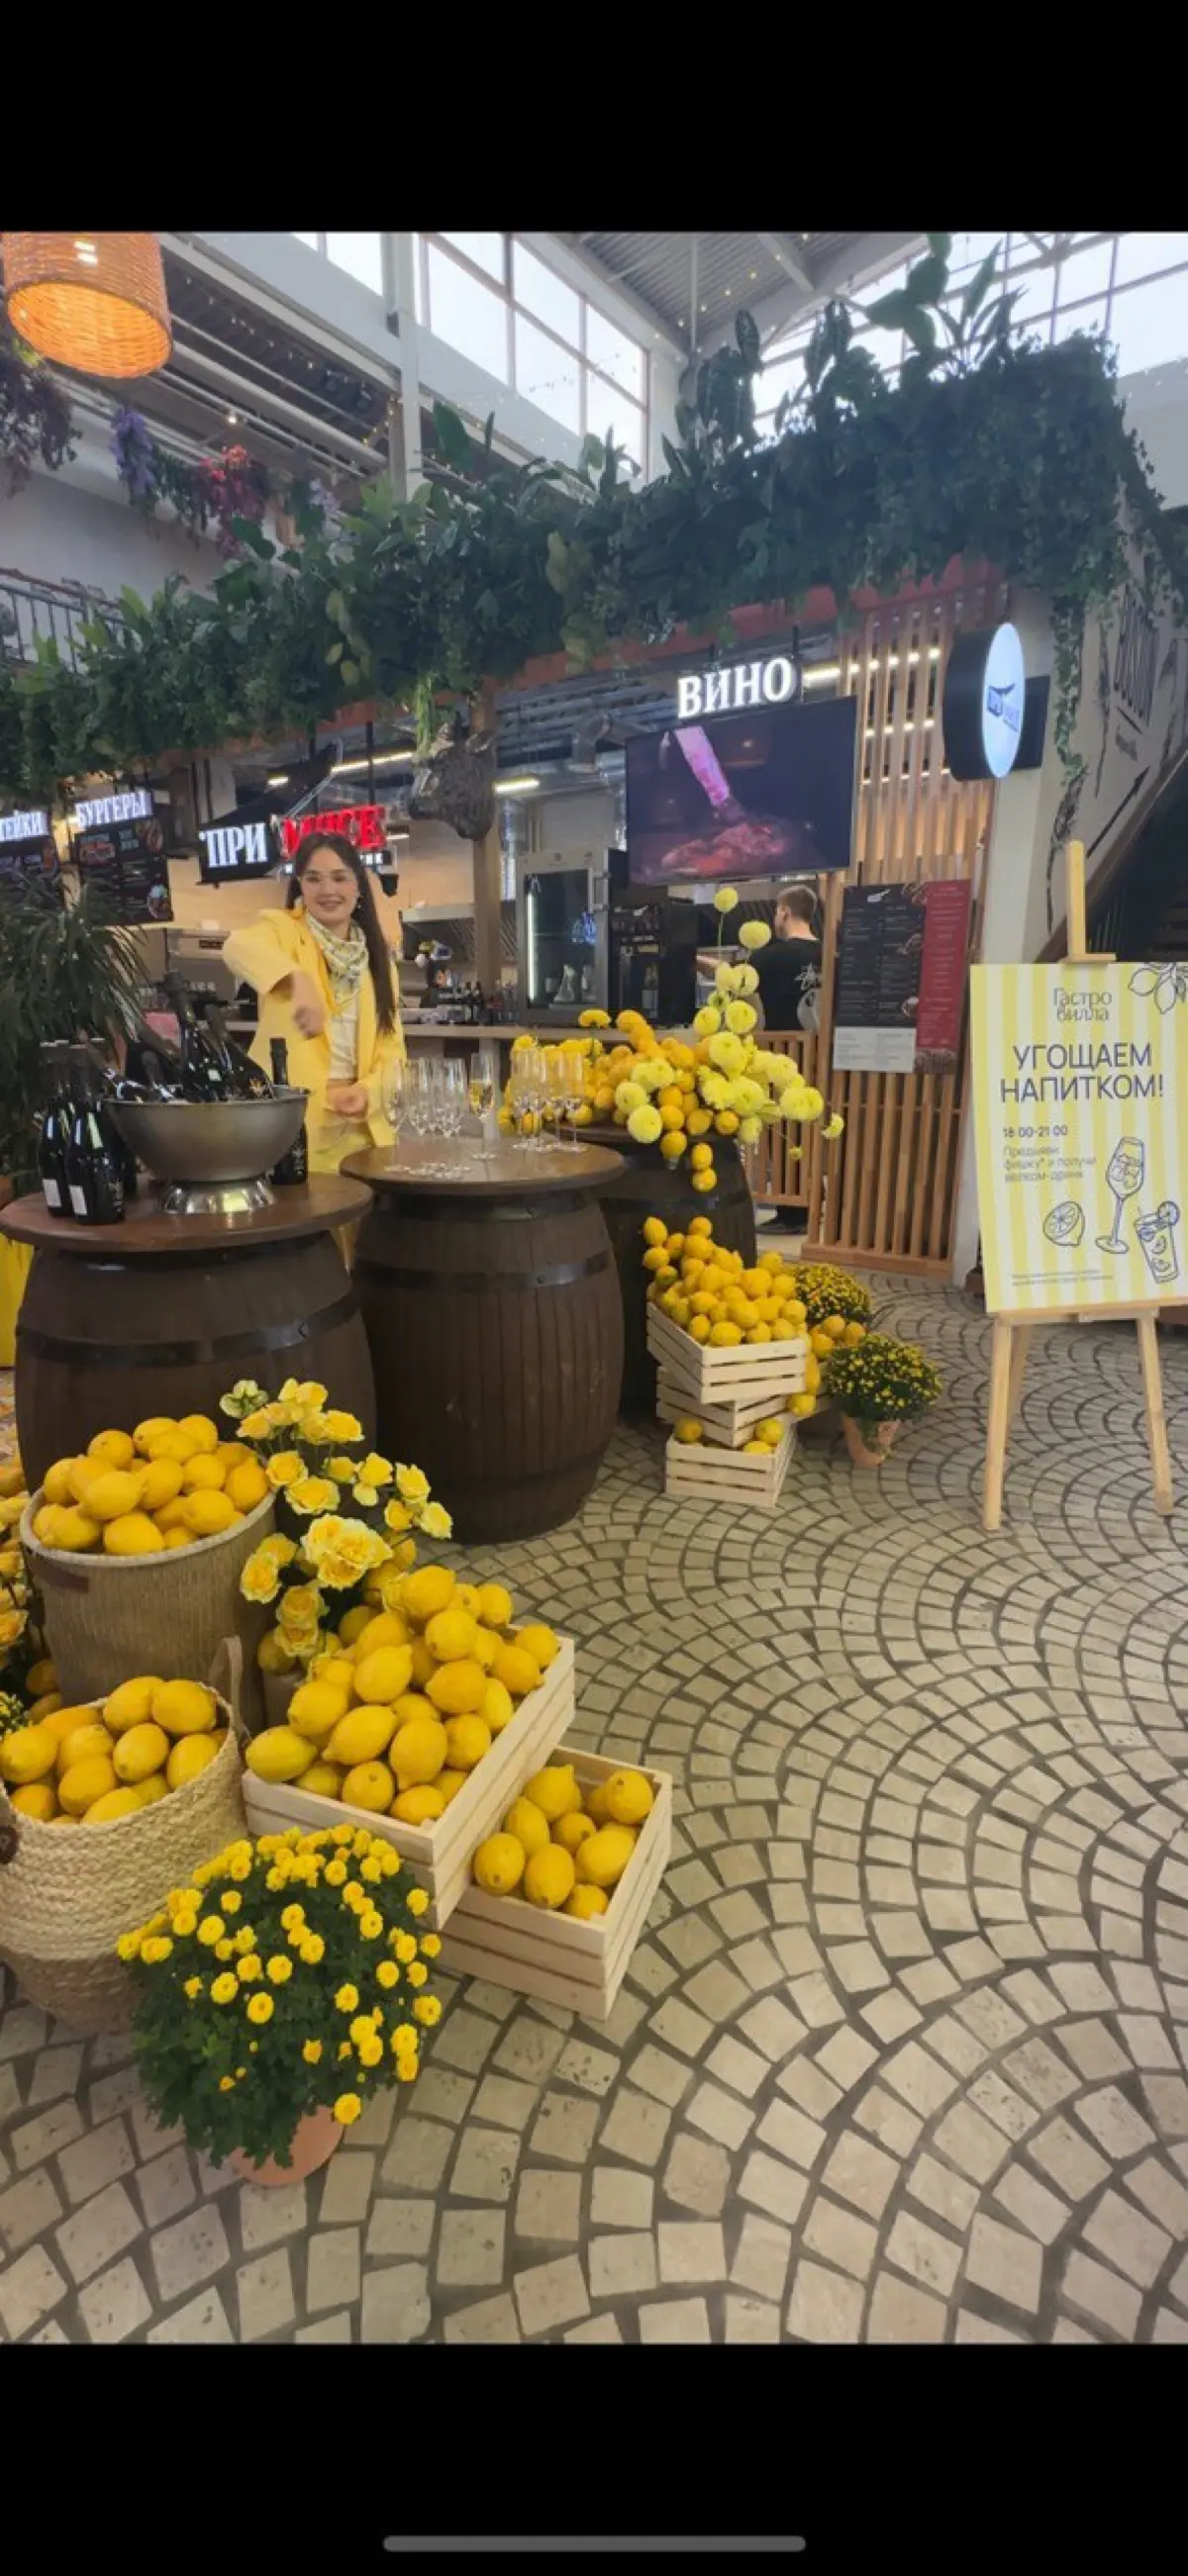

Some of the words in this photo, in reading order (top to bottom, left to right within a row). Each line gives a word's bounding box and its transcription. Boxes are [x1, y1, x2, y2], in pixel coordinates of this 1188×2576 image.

[677, 657, 796, 719] ВИНО
[75, 791, 150, 825] БУРГЕРЫ
[205, 823, 267, 868] ПРИ
[1053, 988, 1112, 1009] Гастро
[1013, 1042, 1152, 1071] УГОЩАЕМ
[1000, 1074, 1164, 1103] НАПИТКОМ!
